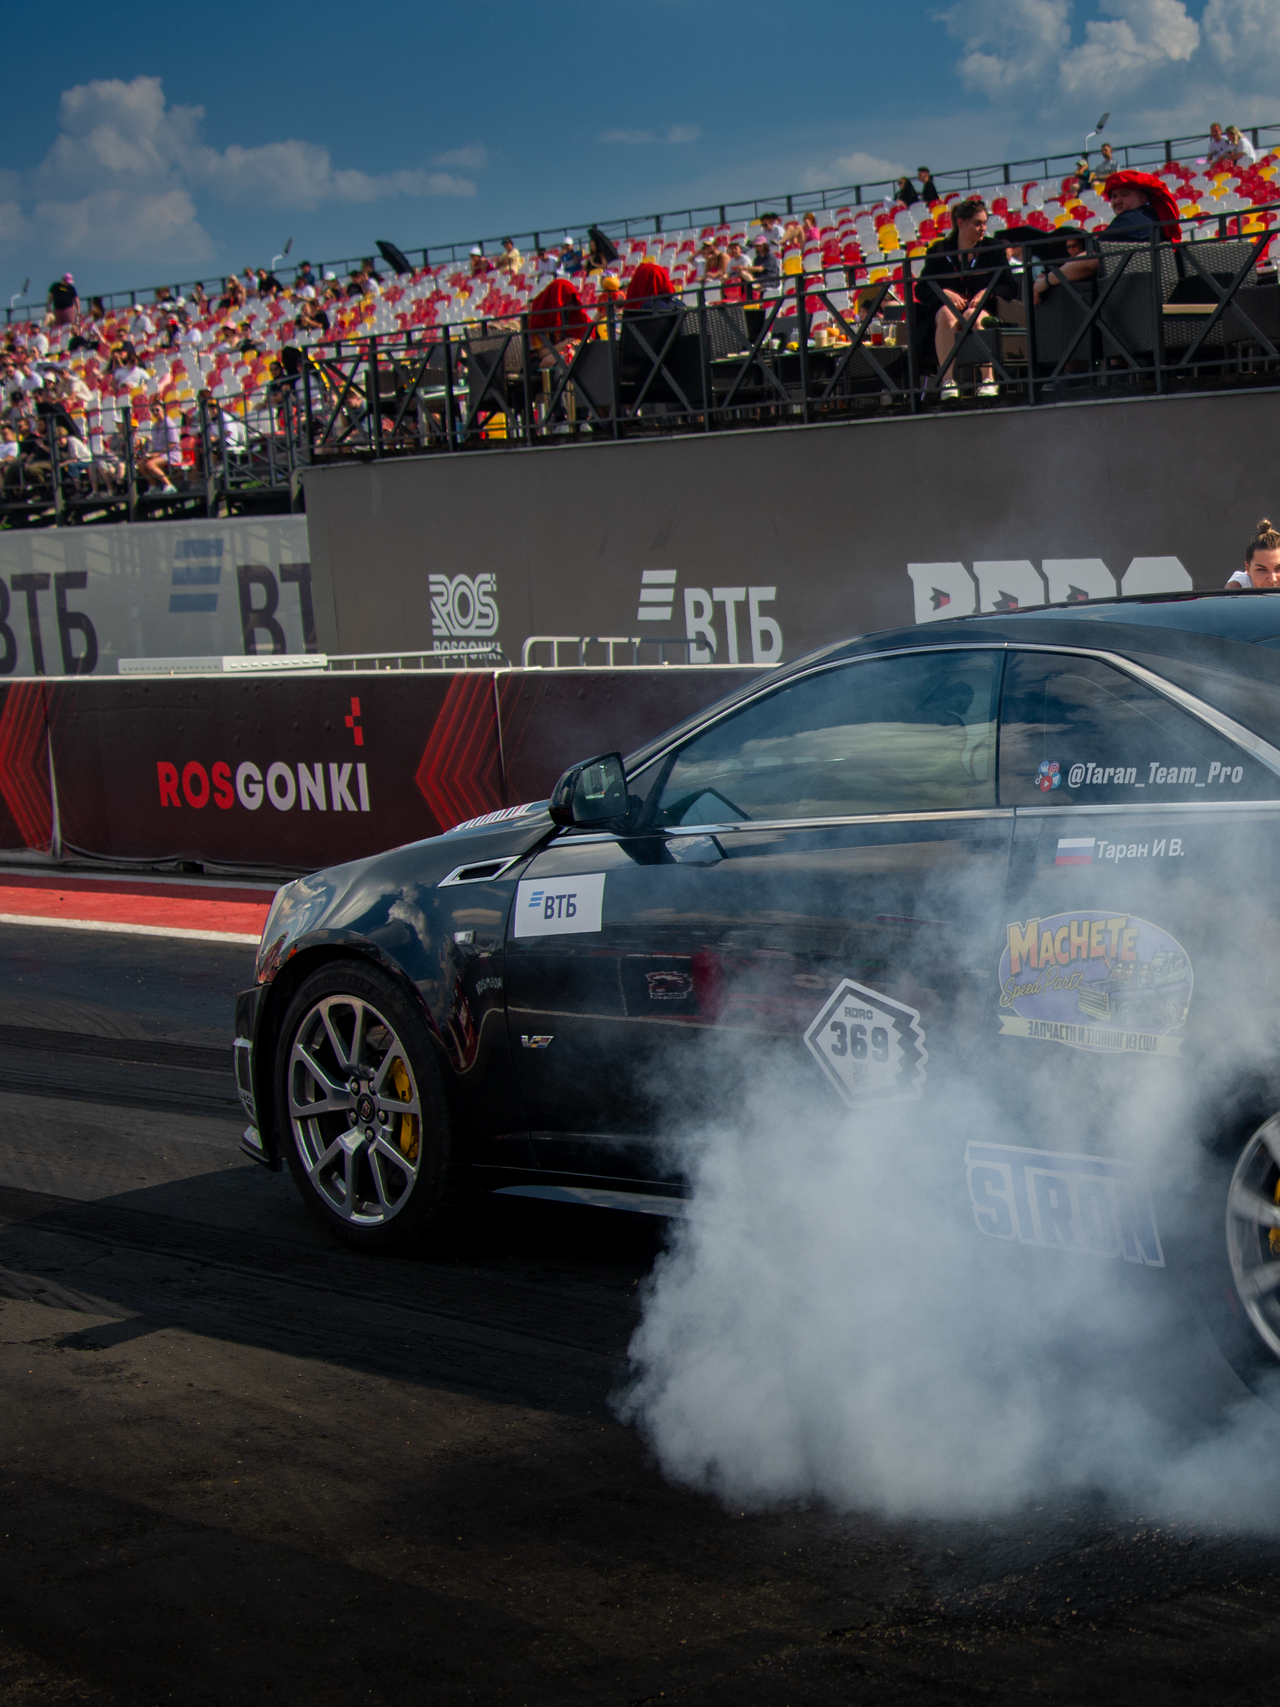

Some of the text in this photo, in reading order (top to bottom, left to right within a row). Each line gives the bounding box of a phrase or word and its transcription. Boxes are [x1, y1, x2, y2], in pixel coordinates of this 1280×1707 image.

[236, 563, 318, 655] ВТ
[428, 573, 499, 636] ROS
[684, 586, 783, 664] ВТБ
[156, 761, 371, 812] ROSGONKI
[1068, 762, 1243, 788] @Taran_Team_Pro
[1097, 840, 1148, 863] Таран
[544, 893, 577, 919] ВТБ
[1001, 966, 1084, 1007] Speed Parts
[844, 1006, 873, 1020] RDRC
[830, 1020, 889, 1063] 369
[1028, 1020, 1158, 1052] ЗАПЧАСТИ И ТЮНИНГ ИЗ США
